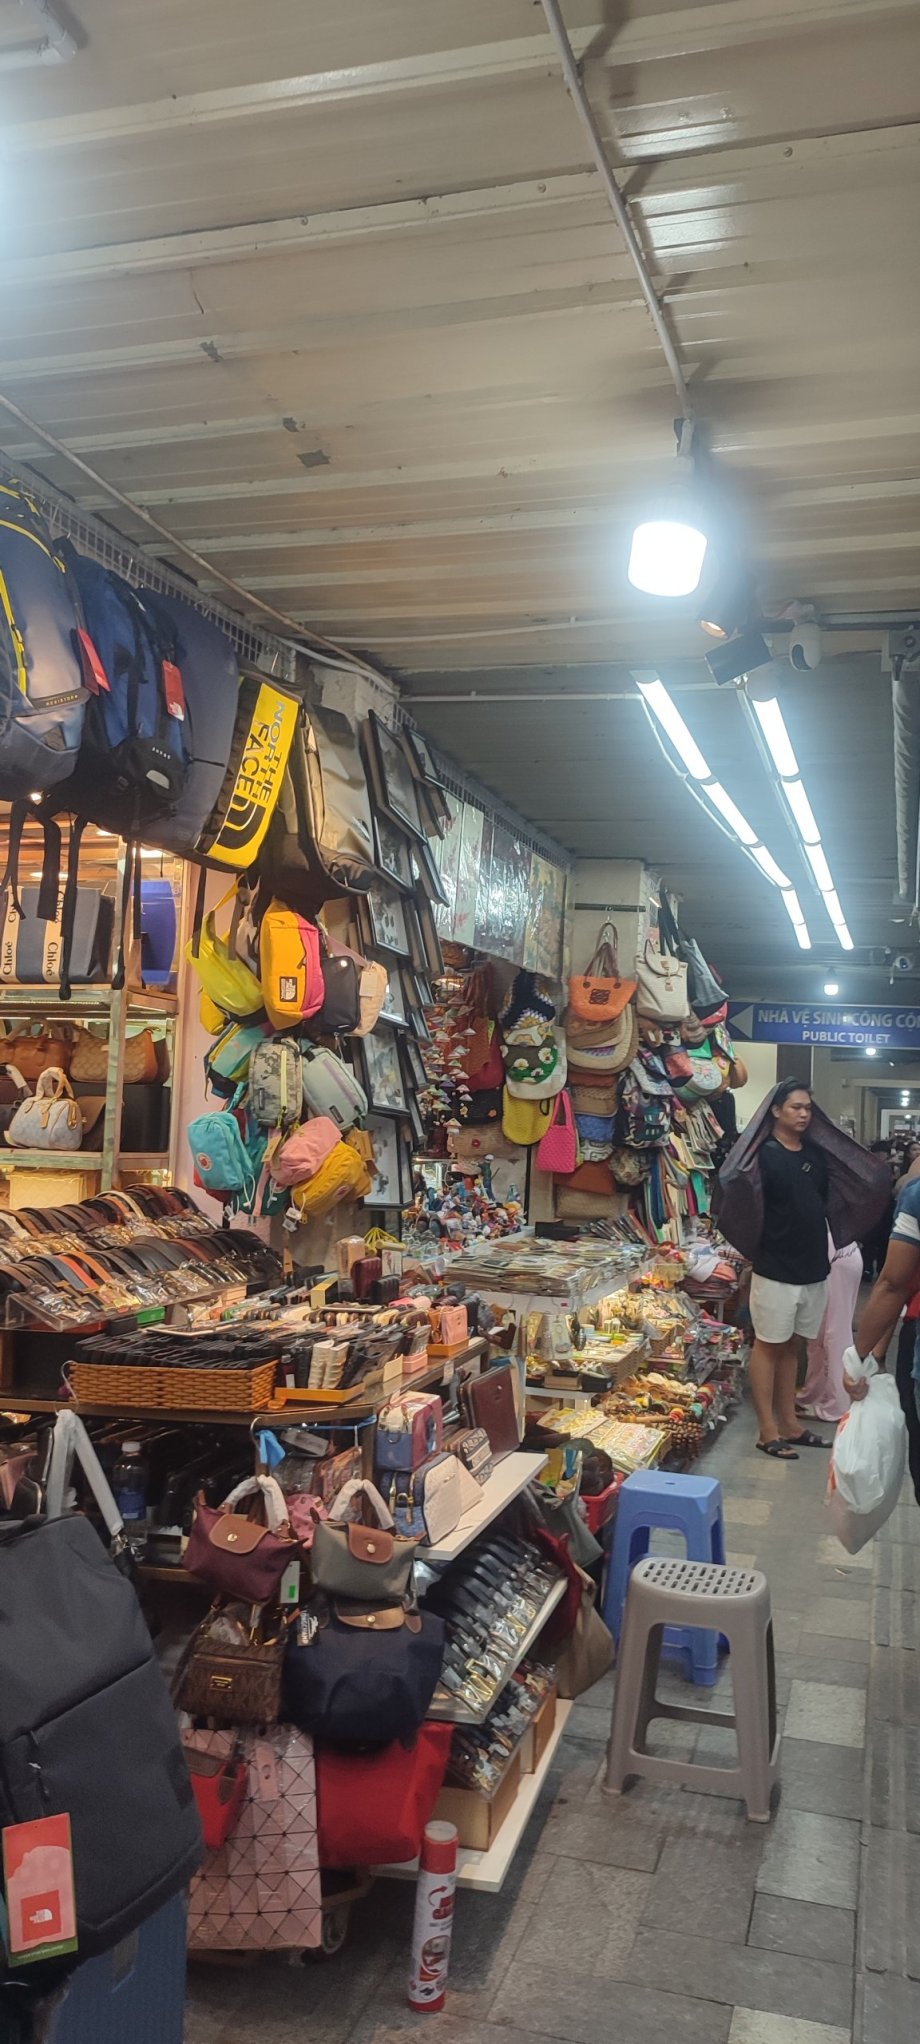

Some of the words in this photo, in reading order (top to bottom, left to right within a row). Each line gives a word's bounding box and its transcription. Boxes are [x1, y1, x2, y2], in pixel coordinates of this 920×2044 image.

[236, 723, 271, 795] FACE
[252, 701, 286, 798] NORTH
[259, 752, 282, 803] THE
[3, 941, 13, 976] Chloé
[46, 942, 59, 976] Chloé
[758, 1008, 789, 1023] NHÀ
[792, 1009, 810, 1028] VỆ
[802, 1031, 846, 1042] PUBLIC
[848, 1032, 891, 1044] TOILET
